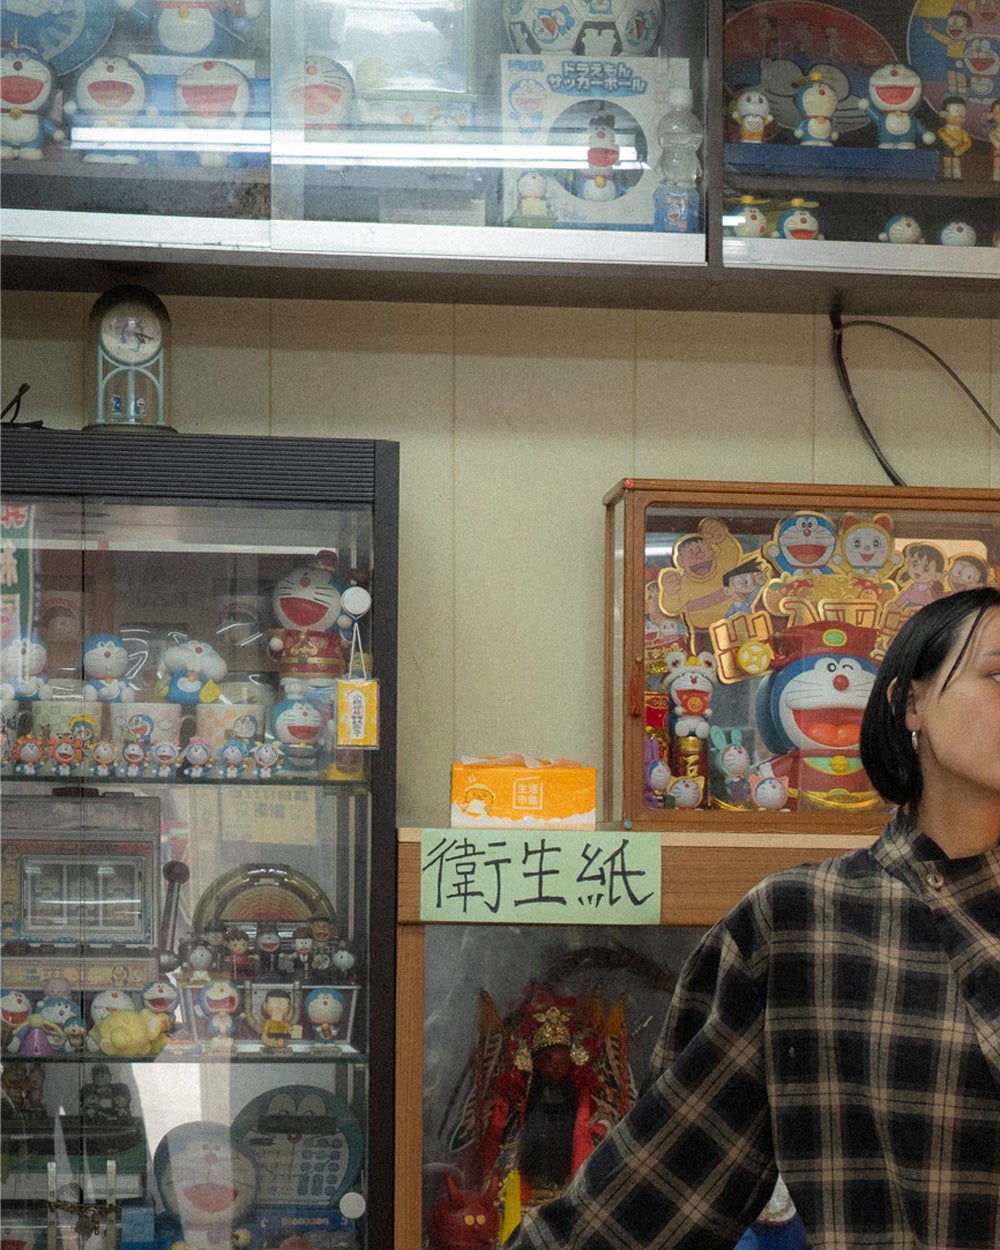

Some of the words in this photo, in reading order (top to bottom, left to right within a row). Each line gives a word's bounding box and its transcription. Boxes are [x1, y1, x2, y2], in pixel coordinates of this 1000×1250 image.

[563, 61, 633, 78] ドラえもん
[422, 838, 655, 914] 衛生紙
